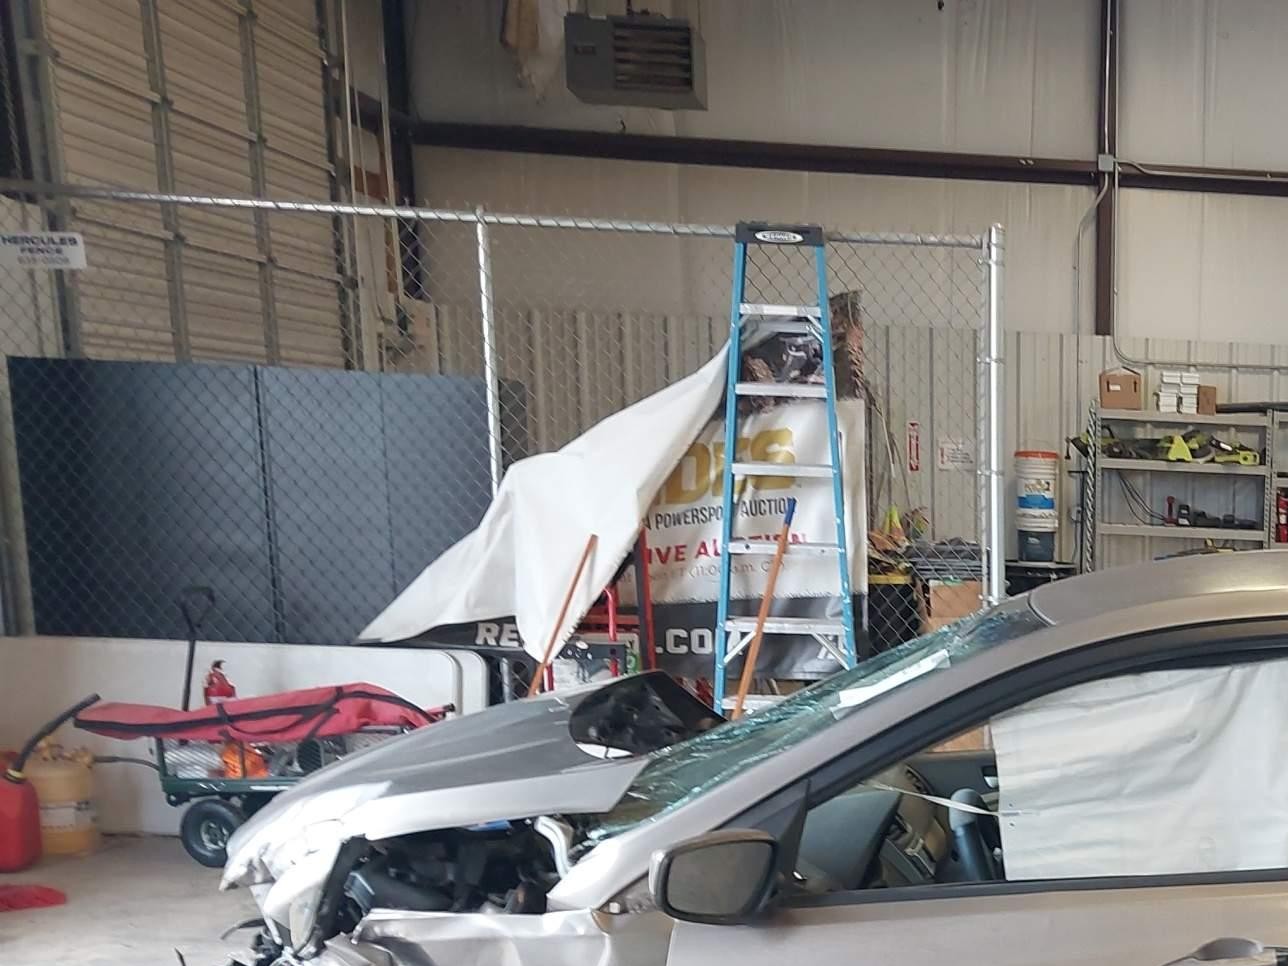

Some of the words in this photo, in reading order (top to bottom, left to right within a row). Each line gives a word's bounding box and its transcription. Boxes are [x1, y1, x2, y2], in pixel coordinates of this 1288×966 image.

[659, 427, 797, 504] DES
[655, 503, 724, 530] POWERSPO
[740, 496, 797, 518] AUCTIO
[648, 544, 688, 565] IVE
[475, 622, 522, 648] RE
